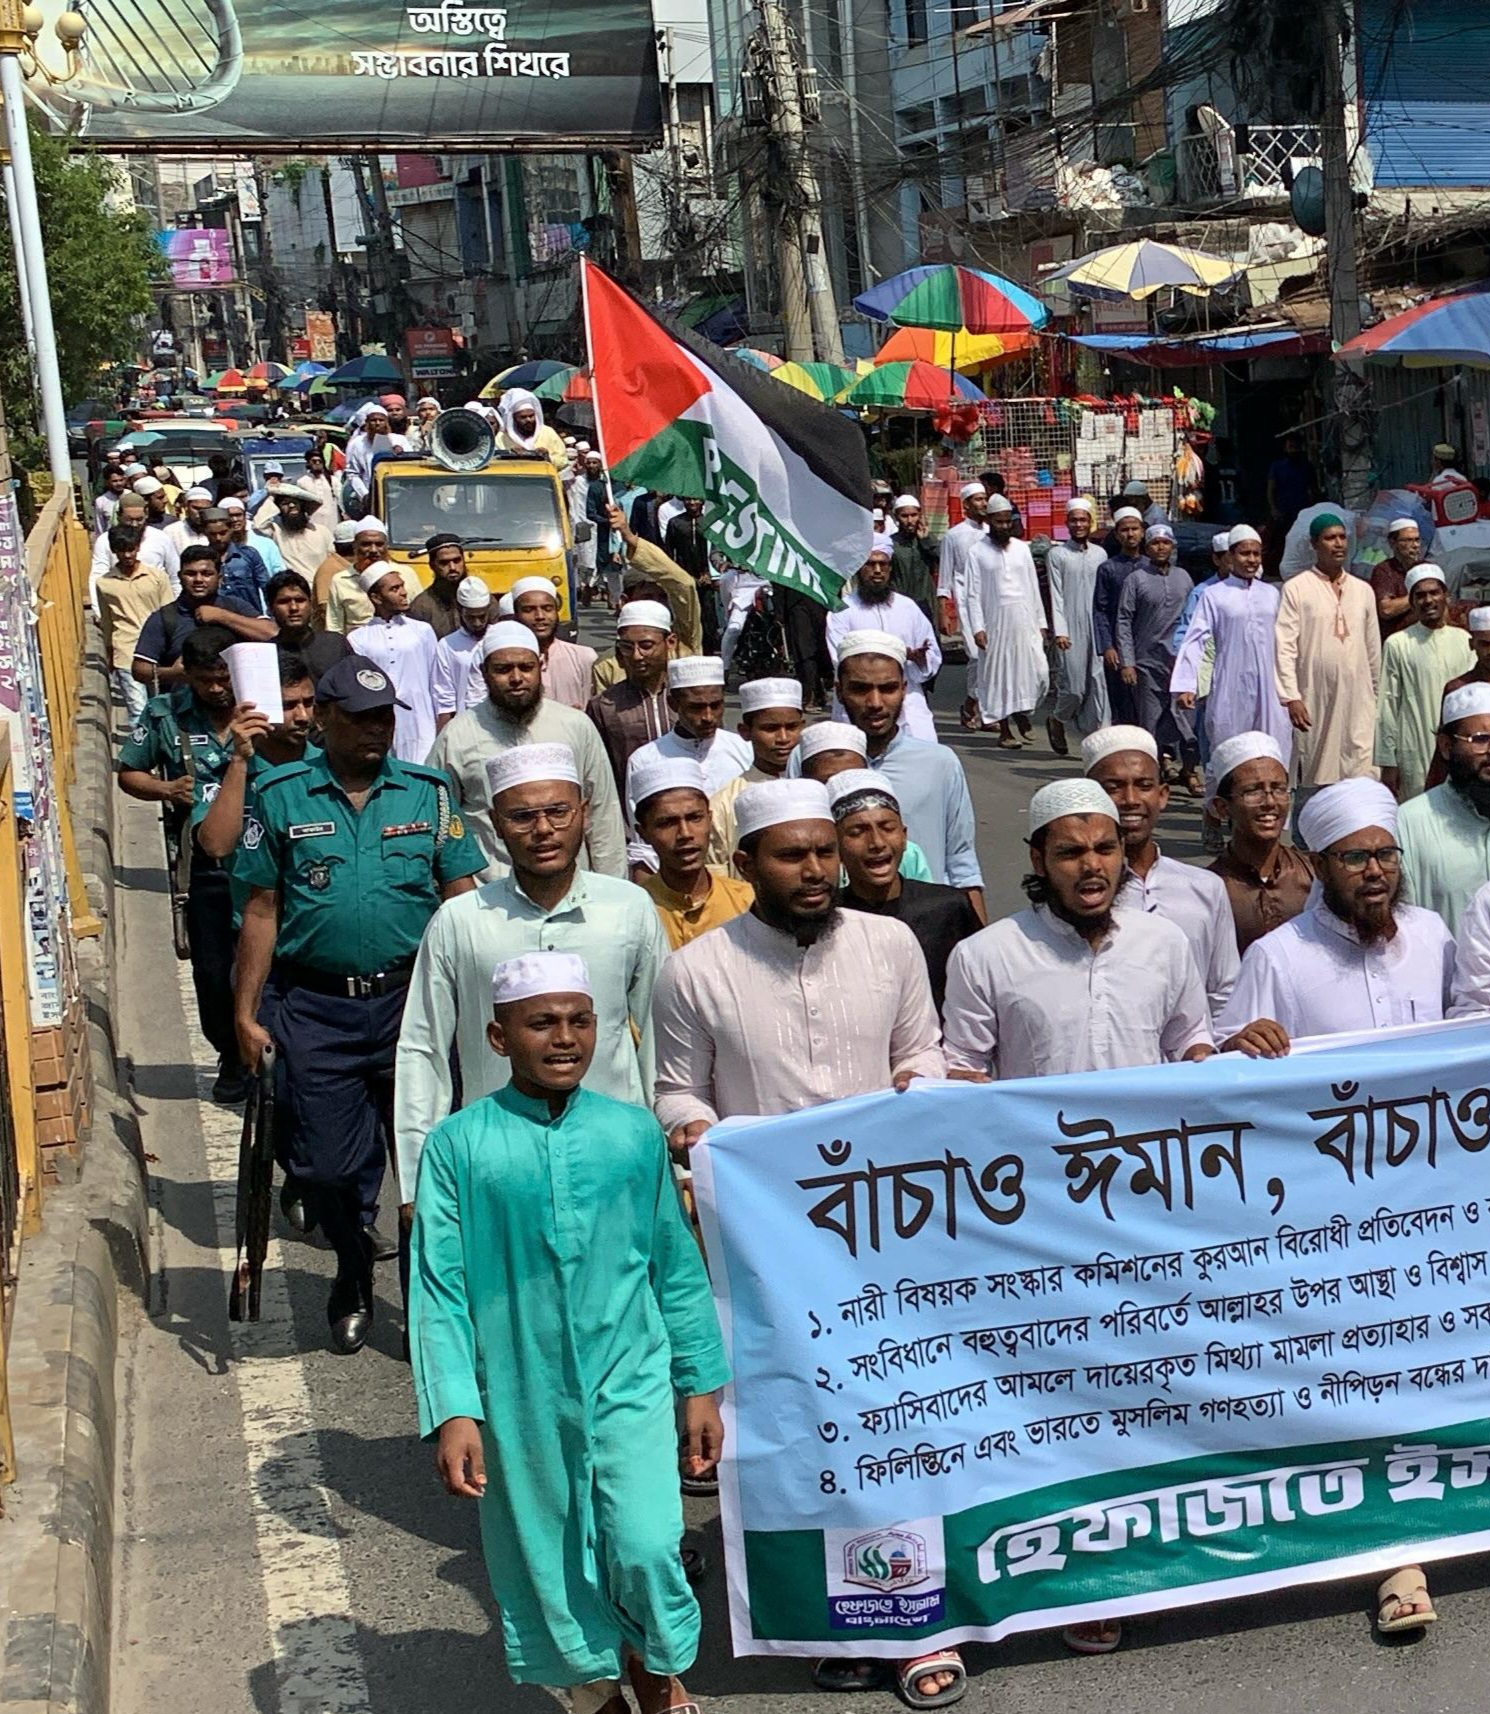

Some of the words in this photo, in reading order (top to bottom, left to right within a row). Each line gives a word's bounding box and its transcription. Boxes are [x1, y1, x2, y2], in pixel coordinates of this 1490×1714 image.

[351, 49, 477, 80] সম্ভাবনার
[485, 43, 570, 80] শিখরে
[795, 1139, 1026, 1260] বাঁচাও
[808, 1310, 832, 1340] ১.
[841, 1284, 887, 1323] নারী
[895, 1272, 977, 1316] বিষয়ক
[986, 1265, 1063, 1301] সংস্কার
[1073, 1251, 1182, 1288] কমিশনের
[1193, 1235, 1269, 1281] কুরআন
[1277, 1214, 1351, 1260] বিরোধী
[1358, 1203, 1454, 1246] প্রতিবেদন
[1464, 1200, 1479, 1225] ও
[816, 1368, 842, 1394] ২.
[849, 1331, 953, 1383] সংবিধানে
[961, 1315, 1089, 1362] বহুত্ববাদের
[1099, 1293, 1194, 1339] পরিবর্তে
[1198, 1289, 1283, 1327] আল্লাহর
[1291, 1276, 1341, 1310] উপর
[1348, 1264, 1397, 1300] আস্থা
[1408, 1263, 1422, 1288] ও
[1427, 1249, 1487, 1287] বিশ্বাস
[817, 1424, 849, 1444] ৩.
[858, 1382, 988, 1435] ফ্যাসিবাদের
[995, 1371, 1073, 1401] আমলে
[1085, 1357, 1196, 1394] দায়েরকৃত
[1206, 1338, 1262, 1377] মিথ্যা
[1271, 1330, 1333, 1364] মামলা
[1342, 1312, 1431, 1353] প্রত্যাহার
[1441, 1307, 1456, 1333] ও
[819, 1470, 847, 1495] ৪.
[857, 1440, 966, 1493] ফিলিস্তিনে
[974, 1433, 1021, 1463] এবং
[1026, 1411, 1101, 1447] ভারতে
[1111, 1398, 1188, 1437] মুসলিম
[1200, 1389, 1285, 1423] গণহত্যা
[1298, 1385, 1312, 1411] ও
[1319, 1370, 1400, 1408] নীপিড়ন
[1410, 1357, 1465, 1391] বন্ধের
[976, 1457, 1372, 1585] হেফাজতে
[835, 1599, 893, 1615] হেফাজতে
[895, 1594, 940, 1615] ইসলাম
